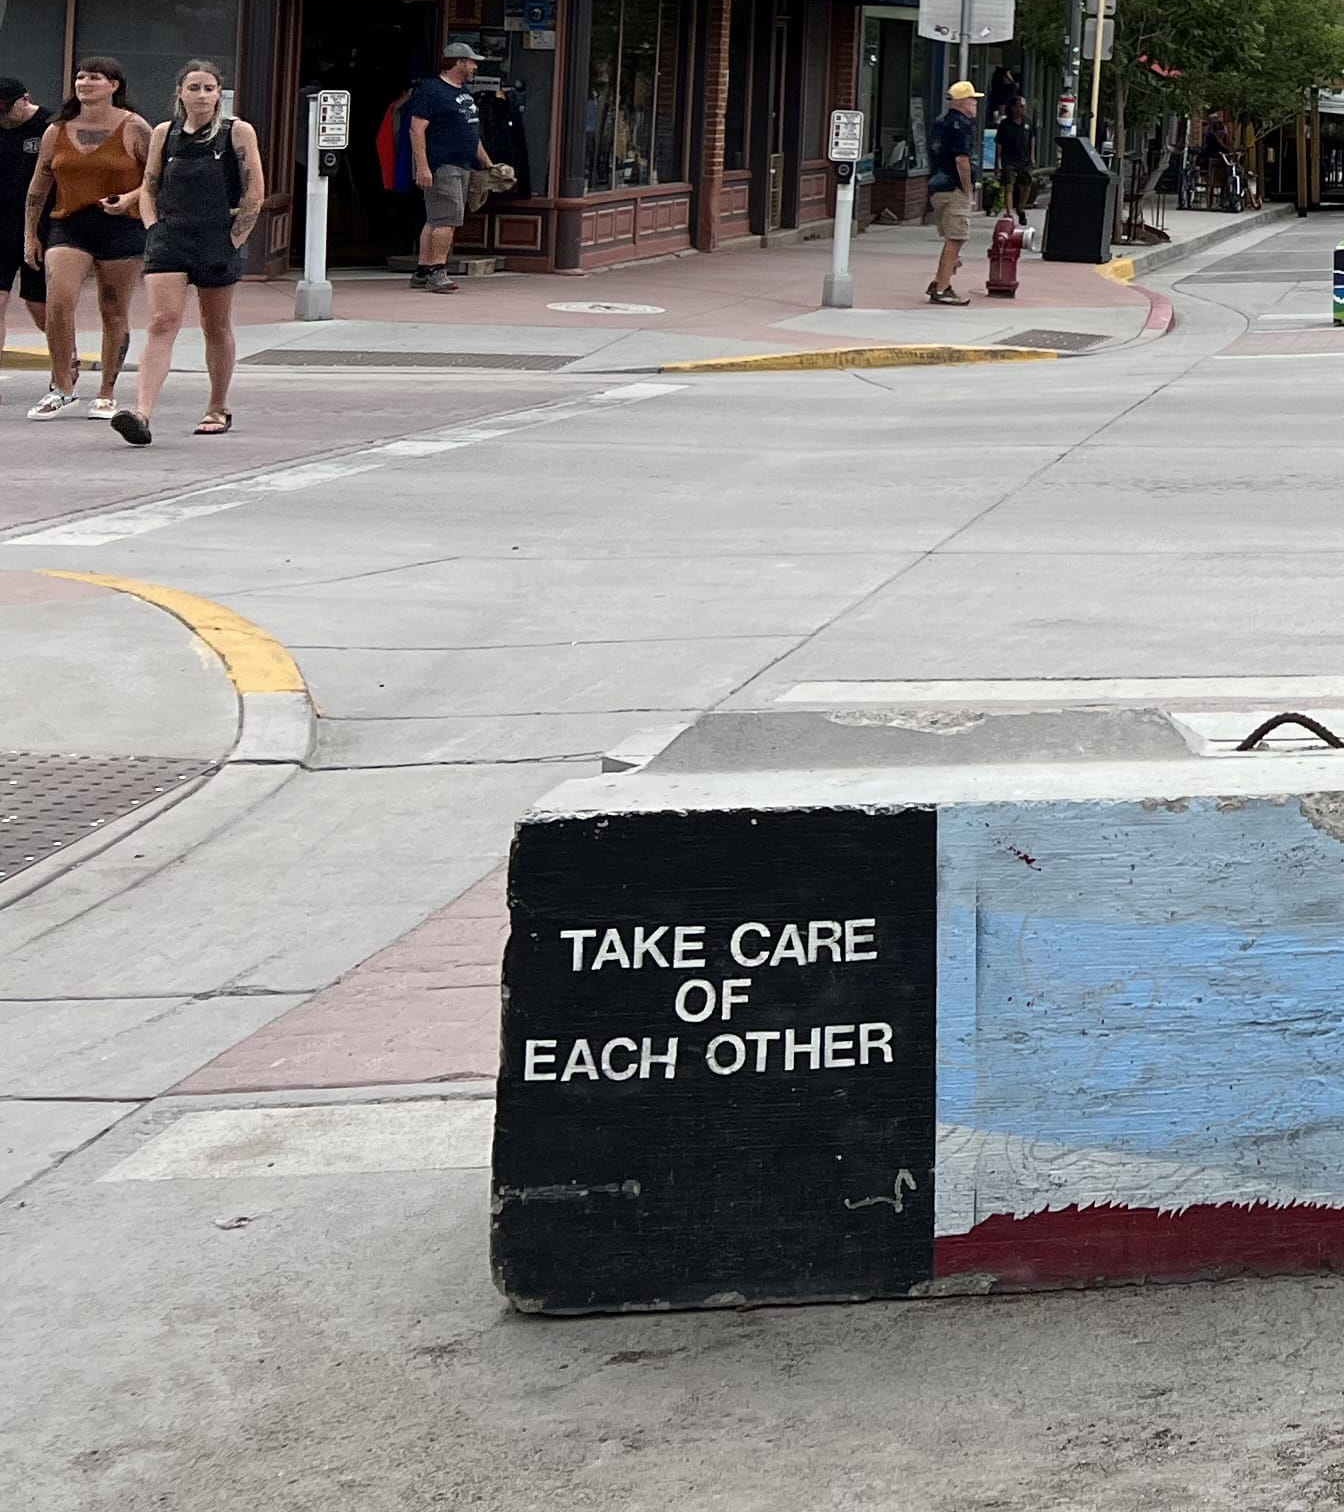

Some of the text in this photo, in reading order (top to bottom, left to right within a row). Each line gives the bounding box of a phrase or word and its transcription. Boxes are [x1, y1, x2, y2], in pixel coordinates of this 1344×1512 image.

[560, 918, 878, 972] TAKE CARE
[675, 978, 752, 1023] OF
[523, 1022, 894, 1082] EACH OTHER
